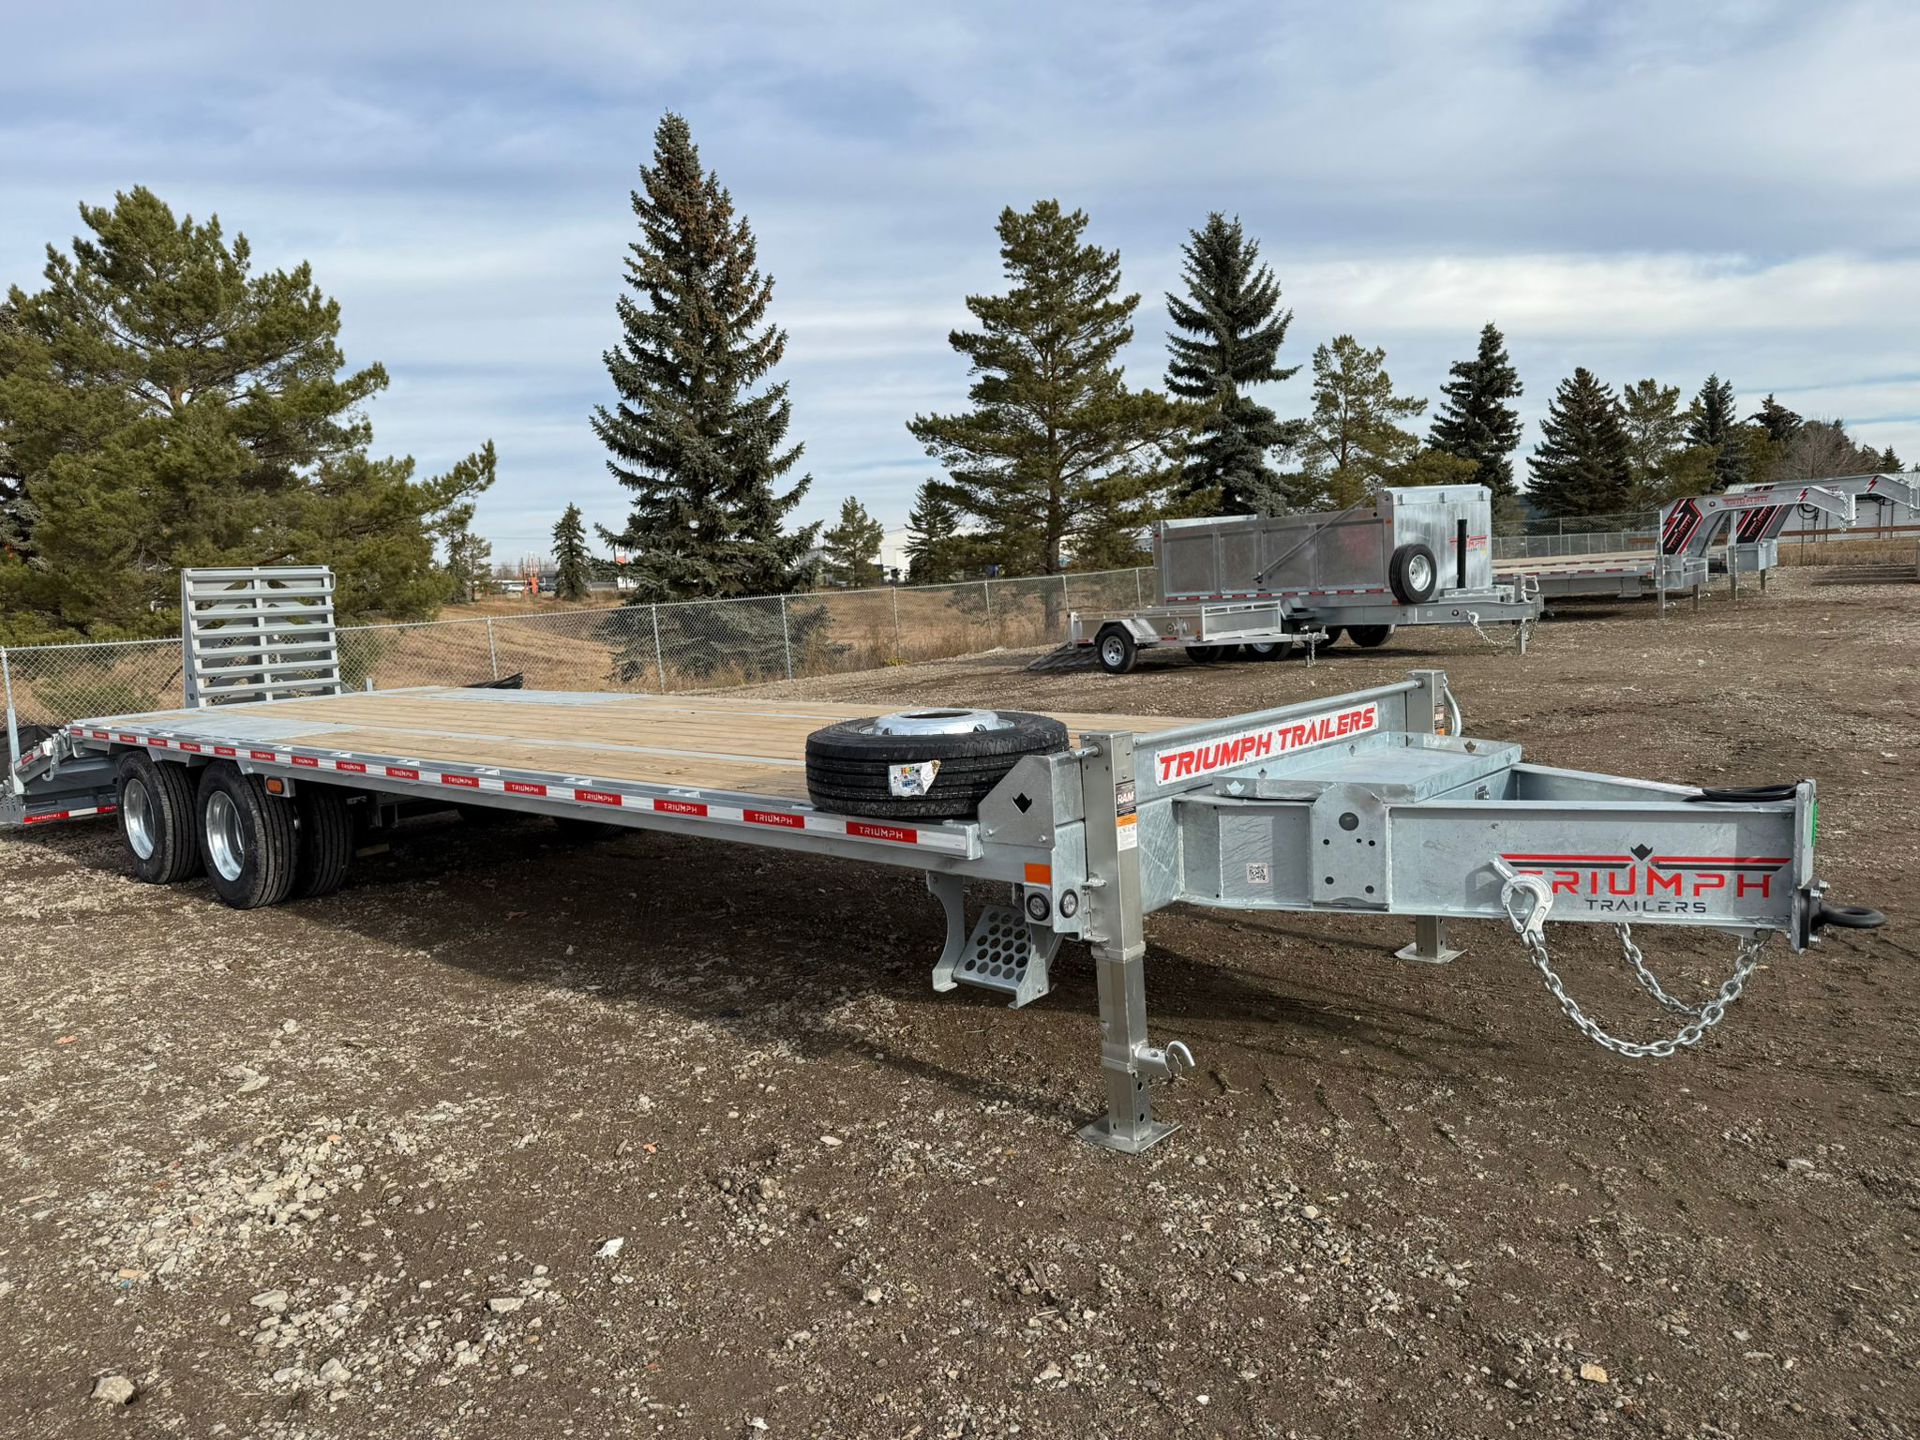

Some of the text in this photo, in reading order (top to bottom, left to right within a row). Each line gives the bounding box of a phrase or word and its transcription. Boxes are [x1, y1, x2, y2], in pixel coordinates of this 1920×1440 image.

[1159, 707, 1376, 781] TRIUMPH TRAILERS
[447, 776, 473, 785] TRIUMPH
[511, 784, 539, 793] TRIUMPH
[583, 792, 613, 803] TRIUMPH
[1117, 791, 1135, 805] RAM
[663, 802, 698, 814] TRIUMPH
[754, 813, 793, 826] TRIUMPH
[859, 826, 904, 840] TRIUMPH
[1585, 899, 1707, 914] TRAILERS
